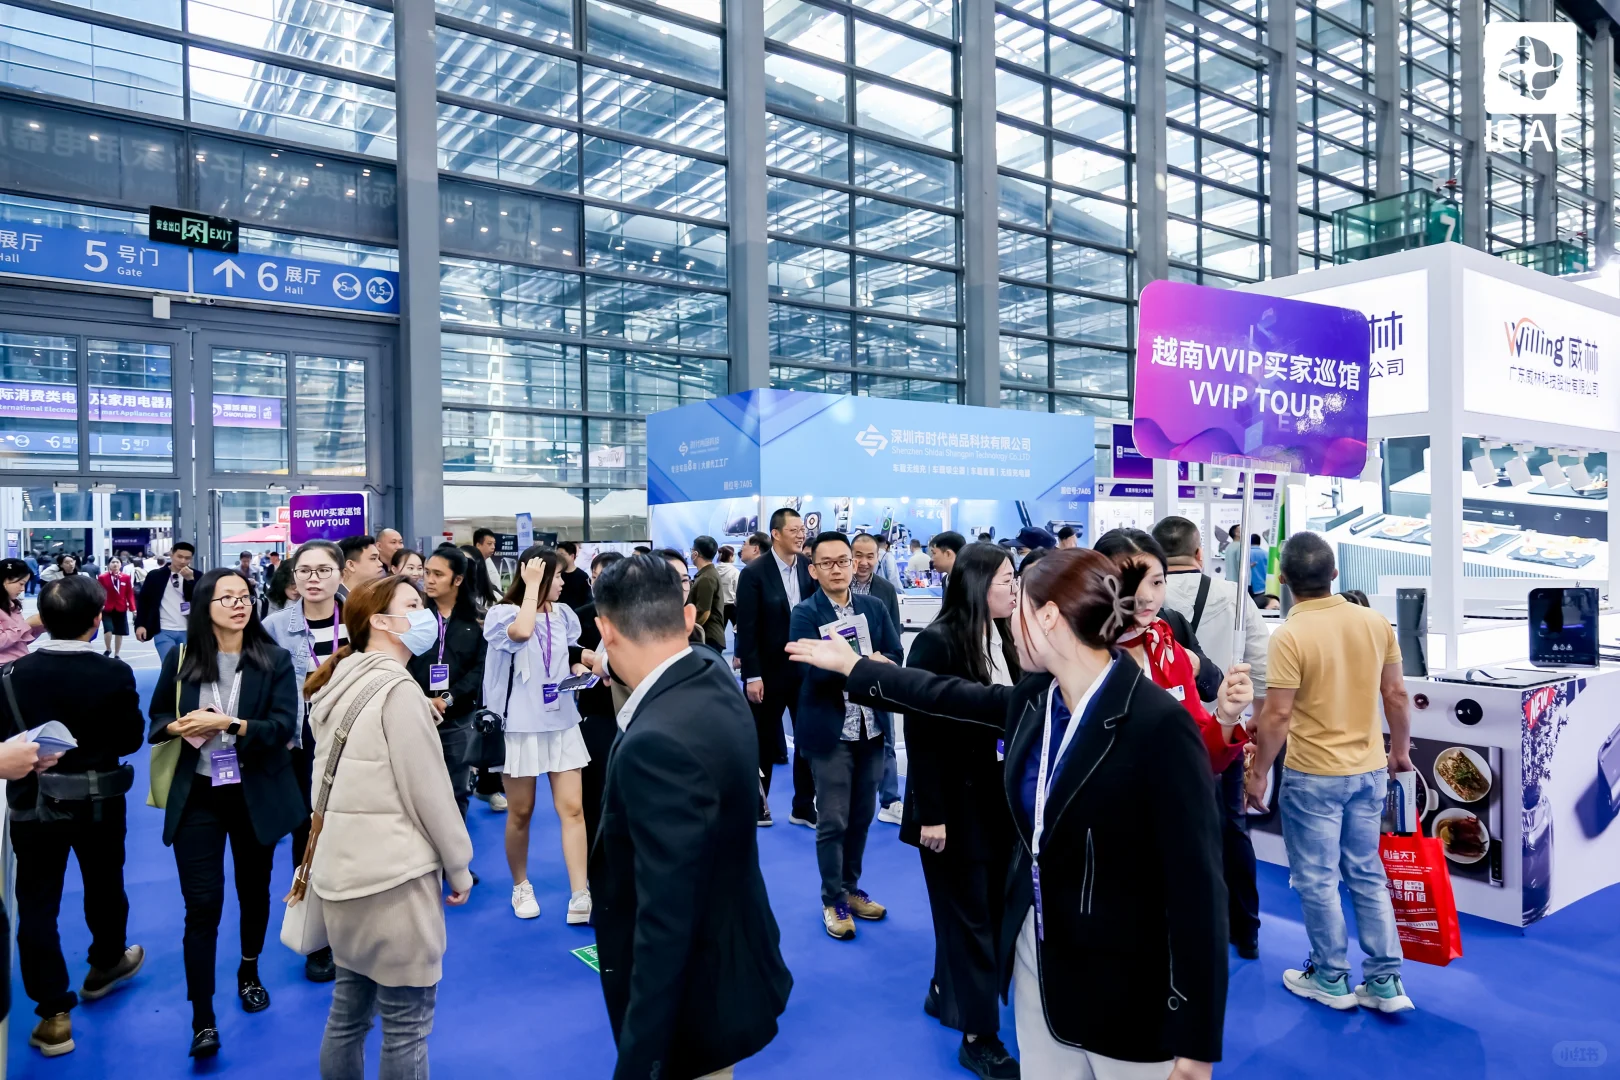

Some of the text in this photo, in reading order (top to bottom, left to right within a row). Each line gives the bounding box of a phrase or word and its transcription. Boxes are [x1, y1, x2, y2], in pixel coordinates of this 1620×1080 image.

[156, 220, 180, 232] 安全出口
[209, 228, 232, 241] EXIT
[1440, 215, 1456, 242] 7
[0, 230, 43, 251] 展厅
[84, 239, 159, 272] 5 号门
[117, 267, 143, 277] Gate
[257, 262, 321, 291] 6 展厅
[284, 286, 303, 295] Hall
[1504, 317, 1598, 375] Willing 威林
[1151, 335, 1361, 391] 越南VVIP买家巡馆
[1369, 358, 1404, 379] 公司
[1189, 380, 1324, 420] VVIP TOUR
[121, 438, 131, 451] 5
[891, 429, 1031, 451] 深圳市时代尚品科技有限公司
[293, 507, 361, 519] 印尼VVIP买家巡馆
[305, 518, 350, 527] VVIP TOUR
[1530, 688, 1550, 726] NEW
